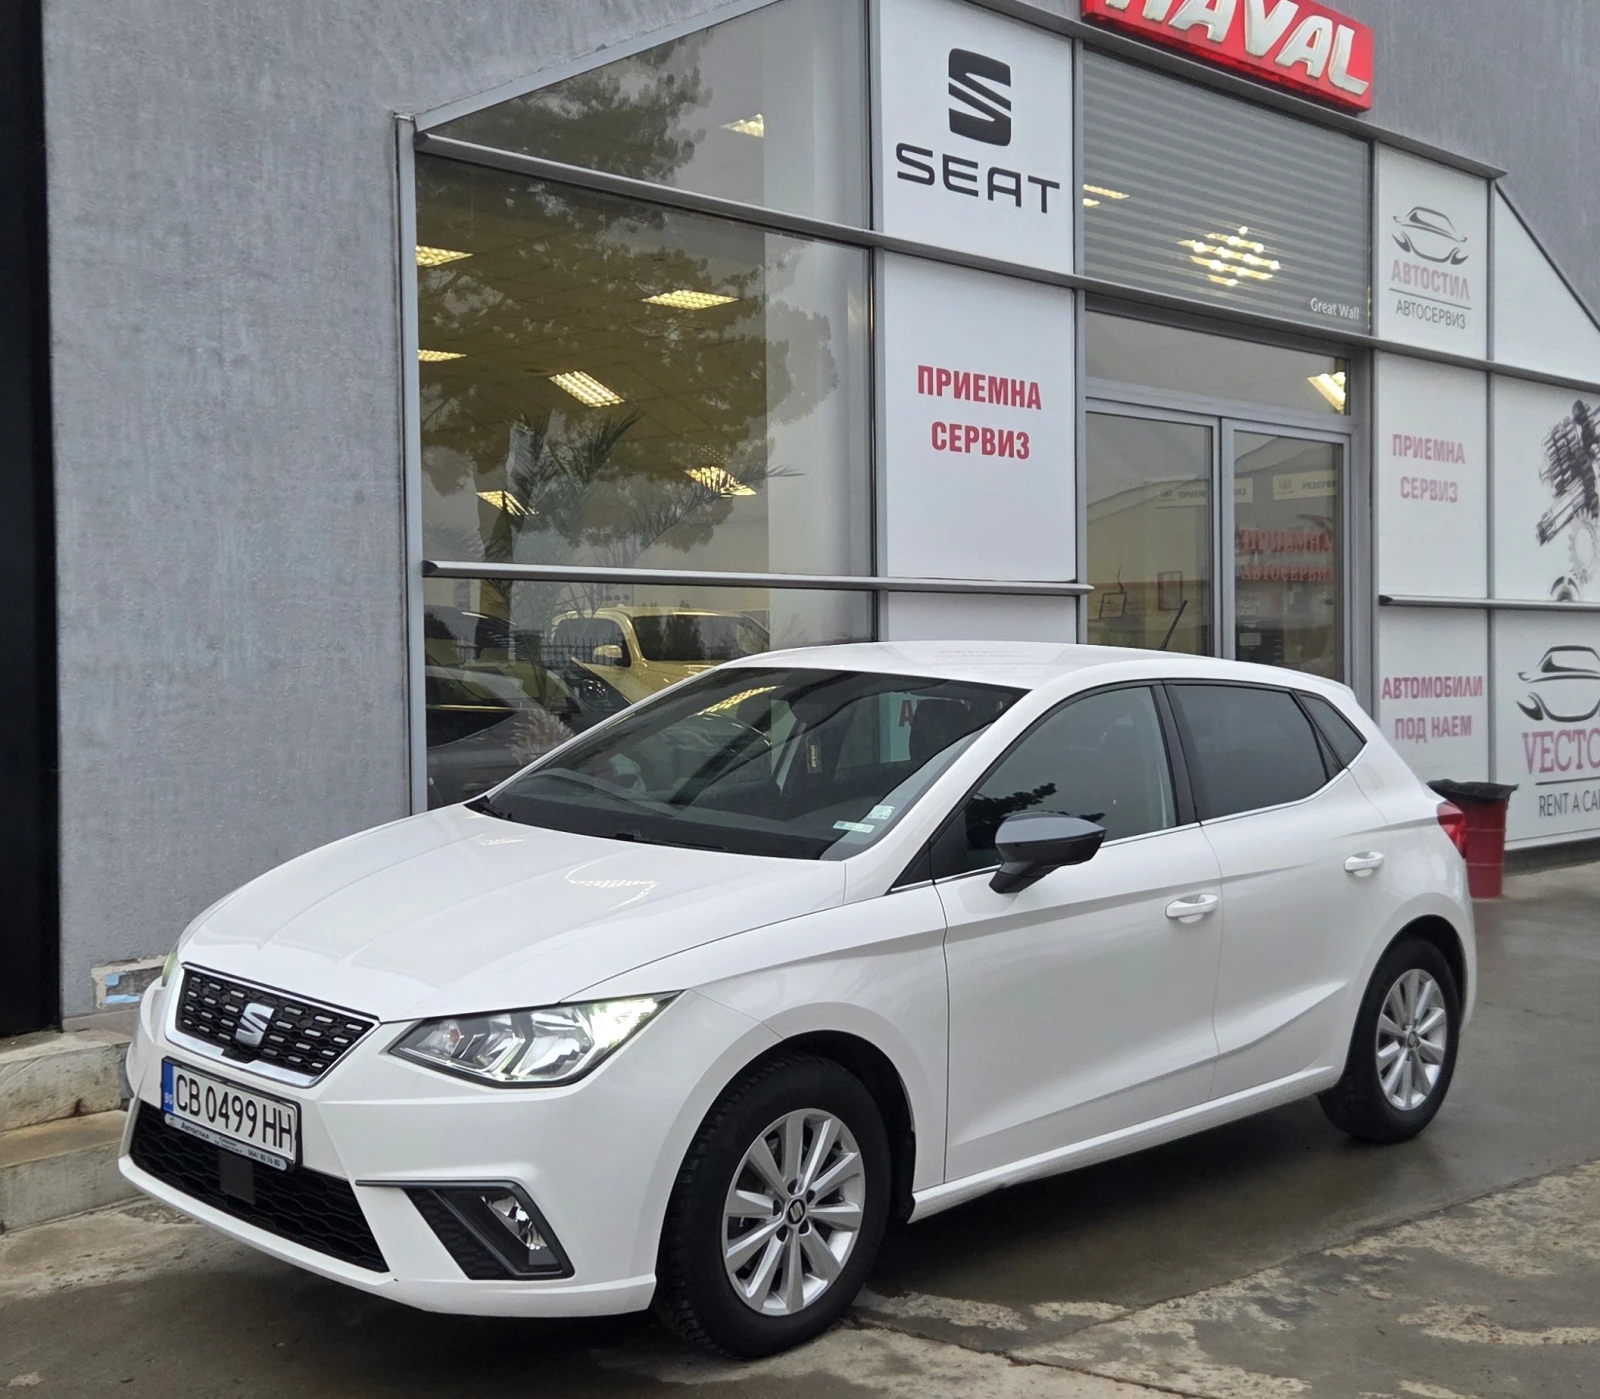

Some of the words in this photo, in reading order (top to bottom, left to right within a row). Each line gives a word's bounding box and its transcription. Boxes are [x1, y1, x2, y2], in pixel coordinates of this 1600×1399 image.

[896, 142, 1061, 214] SEAT
[1391, 259, 1470, 300] АВТОСТИЛ
[1310, 297, 1338, 317] Great
[1339, 302, 1360, 321] Wall
[1396, 299, 1466, 330] АВТОСЕРВИЗ
[918, 364, 1042, 410] ПРИЕМНА
[931, 421, 1030, 460] СЕРВИЗ
[1392, 433, 1466, 465] ПРИЕМНА
[1400, 476, 1458, 503] СЕРВИЗ
[1381, 676, 1482, 700] АВТОМОБИЛИ
[1395, 717, 1427, 744] ПОД
[1431, 714, 1472, 738] НАЕМ
[1539, 793, 1569, 817] RENT
[1572, 792, 1580, 813] A
[1583, 789, 1600, 812] CA
[206, 1085, 258, 1139] 0499
